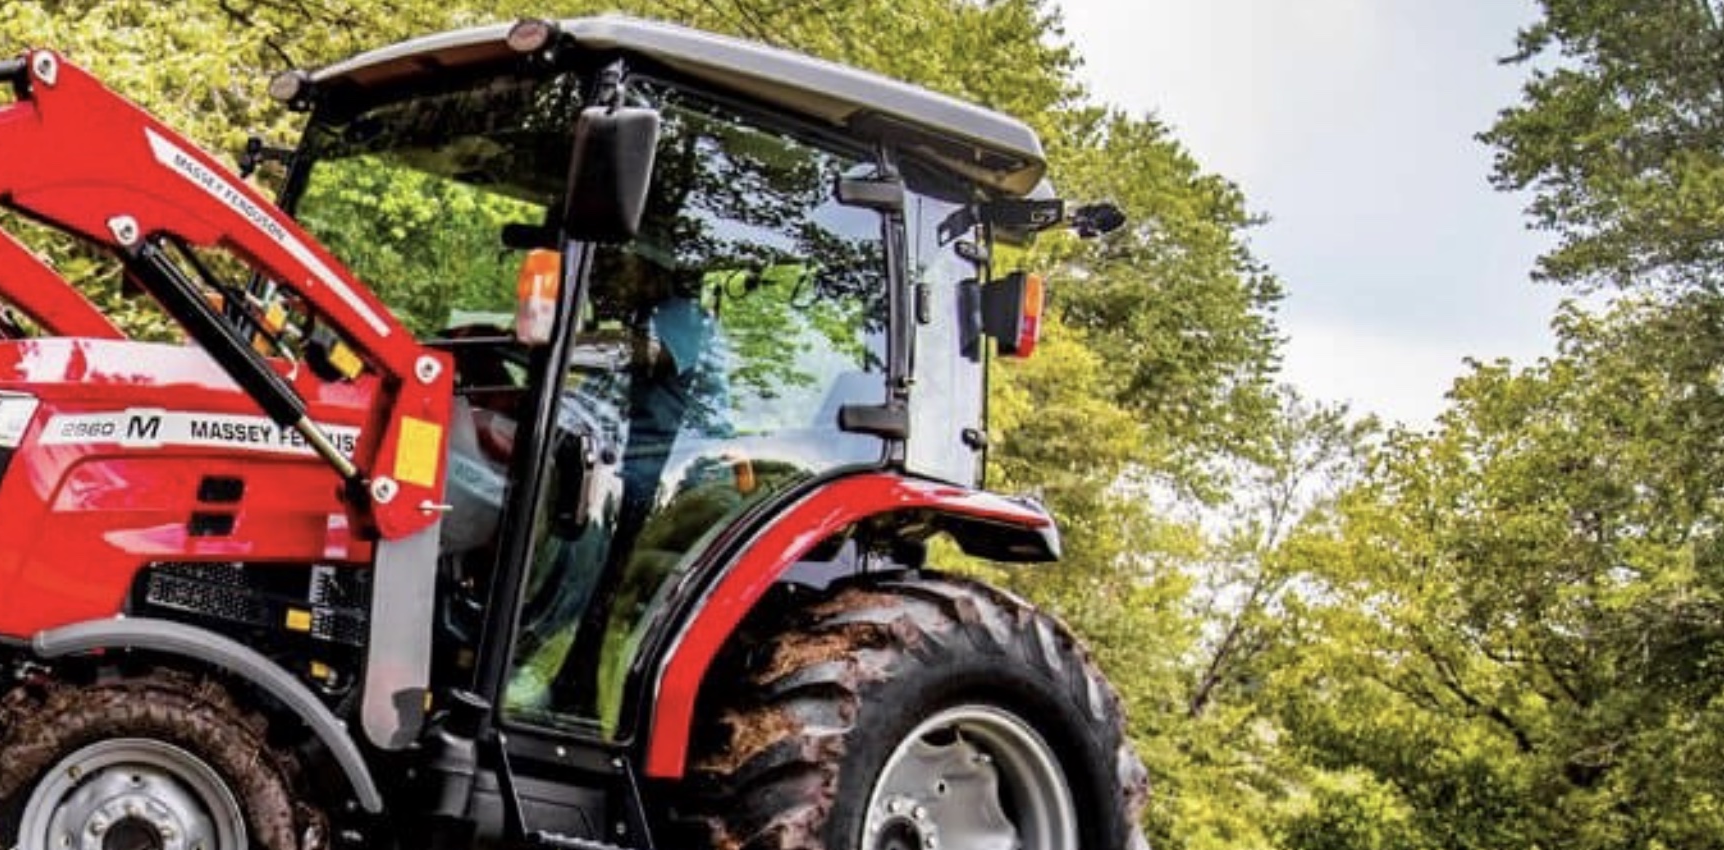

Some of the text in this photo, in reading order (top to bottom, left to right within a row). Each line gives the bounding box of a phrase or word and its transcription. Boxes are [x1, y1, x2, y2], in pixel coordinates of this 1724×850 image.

[174, 152, 287, 241] MASSEY FERGUSON
[127, 415, 162, 439] M
[190, 420, 272, 443] MASSEY
